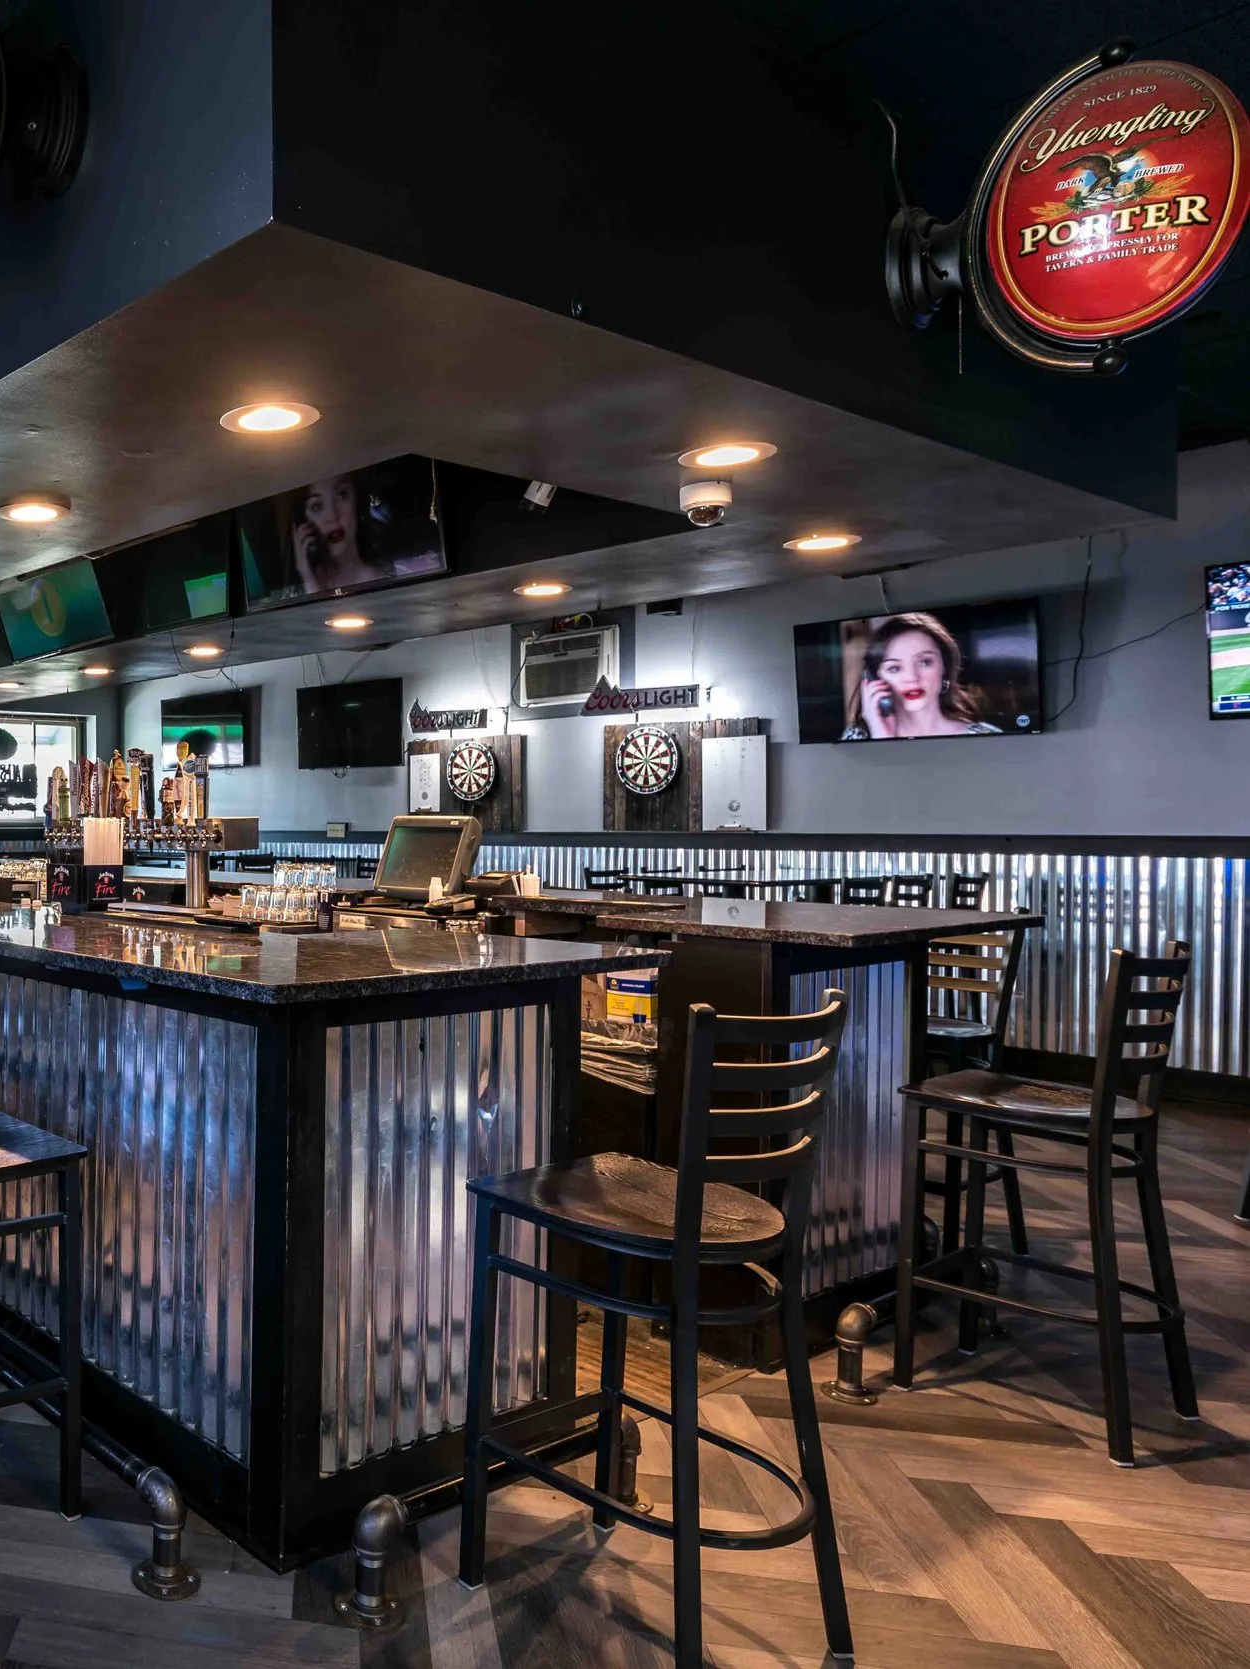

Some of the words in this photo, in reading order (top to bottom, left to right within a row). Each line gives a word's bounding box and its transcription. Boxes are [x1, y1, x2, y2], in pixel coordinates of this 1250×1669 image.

[1083, 90, 1125, 108] SINCE
[1130, 84, 1157, 97] 1829
[1020, 98, 1216, 172] Yuengling
[1057, 176, 1086, 190] DARK
[1134, 164, 1184, 179] BREWED
[1019, 195, 1211, 255] PORTER
[1156, 232, 1179, 243] FOR
[1045, 258, 1084, 272] TAVERN
[1086, 255, 1095, 265] &
[1097, 246, 1143, 263] FAMILY
[1141, 242, 1180, 256] TRADE
[584, 687, 642, 711] Coors
[644, 688, 697, 707] LIGHT
[409, 710, 444, 729] Coors
[446, 711, 479, 726] LIGHT
[51, 882, 71, 899] Fire
[95, 882, 116, 898] Fire
